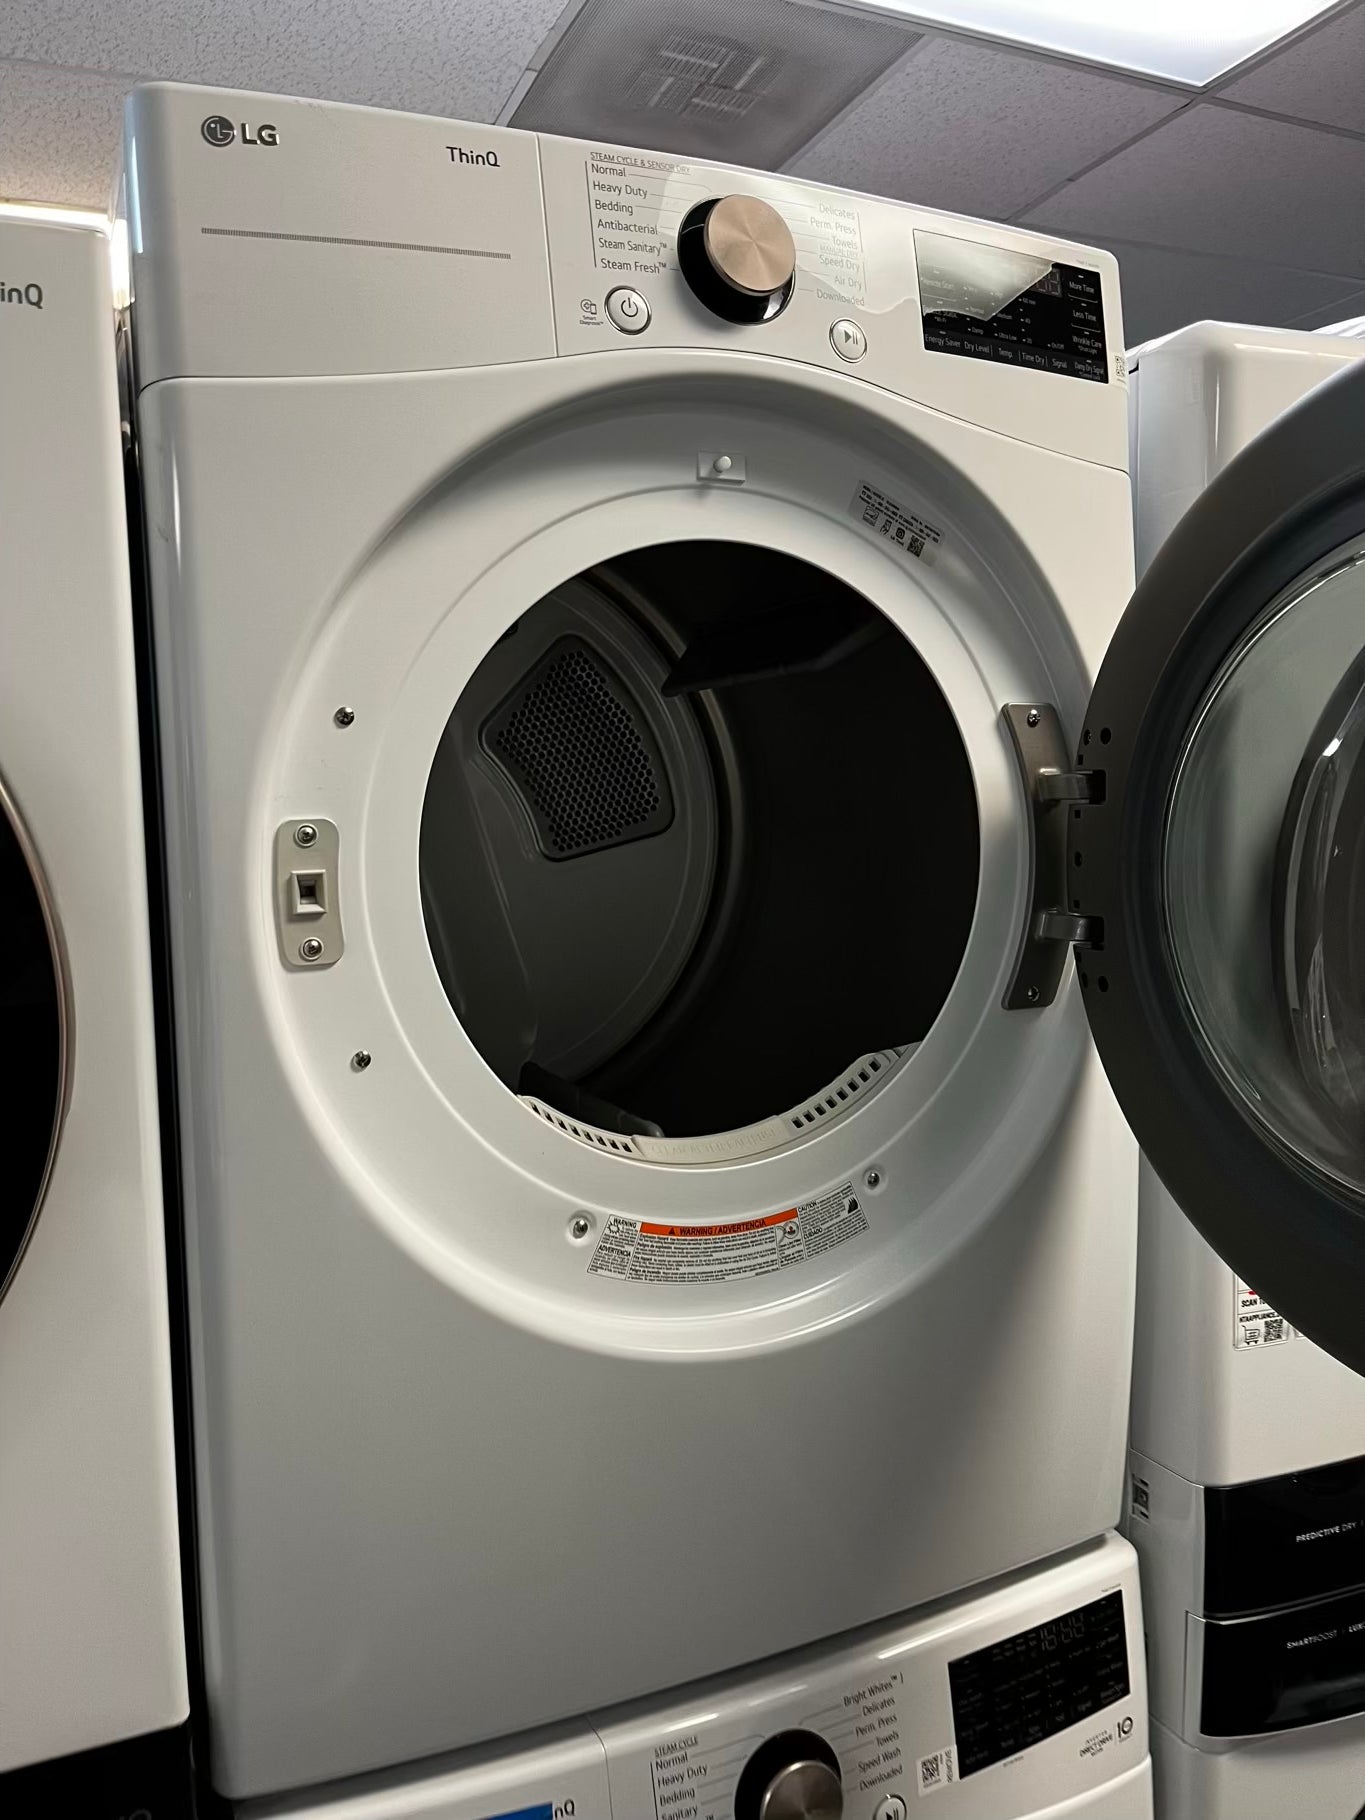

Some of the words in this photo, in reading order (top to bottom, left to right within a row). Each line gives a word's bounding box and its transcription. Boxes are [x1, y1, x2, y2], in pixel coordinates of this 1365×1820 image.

[240, 122, 280, 146] LG
[445, 146, 501, 167] ThinQ
[590, 152, 615, 161] STEAM
[617, 155, 639, 166] CYCLE
[591, 163, 626, 177] Normal
[593, 180, 622, 196] Heavy
[625, 184, 648, 200] Duty
[595, 199, 634, 216] Bedding
[819, 202, 855, 220] Delicates
[597, 219, 658, 235] Antibacterial
[835, 222, 857, 235] Press
[598, 237, 626, 250] Steam
[832, 236, 858, 250] Towels
[600, 258, 632, 271] Steam
[819, 254, 844, 269] Speed
[846, 259, 860, 273] Dry
[834, 275, 845, 285] Air
[848, 277, 862, 292] Dry
[0, 281, 43, 310] inQ
[816, 288, 865, 307] Downloaded
[924, 334, 944, 347] Energy
[945, 337, 961, 348] Saver
[964, 341, 975, 352] Dry
[975, 343, 990, 353] Level
[1021, 352, 1035, 362] Time
[1035, 355, 1045, 366] Dry
[613, 1217, 637, 1229] WARNING
[679, 1226, 713, 1236] WARNING
[718, 1219, 767, 1235] ADVERTENCIA
[1241, 1298, 1258, 1307] SCAN
[1296, 1525, 1340, 1542] PREDICTIVE
[1341, 1521, 1357, 1532] DRY
[843, 1690, 867, 1707] Bright
[862, 1696, 896, 1717] Delicates
[877, 1714, 898, 1729] Press
[1117, 1716, 1134, 1739] 10
[654, 1742, 677, 1759] STEAM
[678, 1735, 699, 1750] CYCLE
[876, 1730, 900, 1747] Towels
[655, 1751, 688, 1771] Normal
[858, 1754, 881, 1773] Speed
[881, 1747, 902, 1763] Wash
[657, 1772, 685, 1789] Heavy
[686, 1764, 708, 1780] Duty
[859, 1763, 903, 1792] Downloaded
[660, 1787, 695, 1807] Bedding
